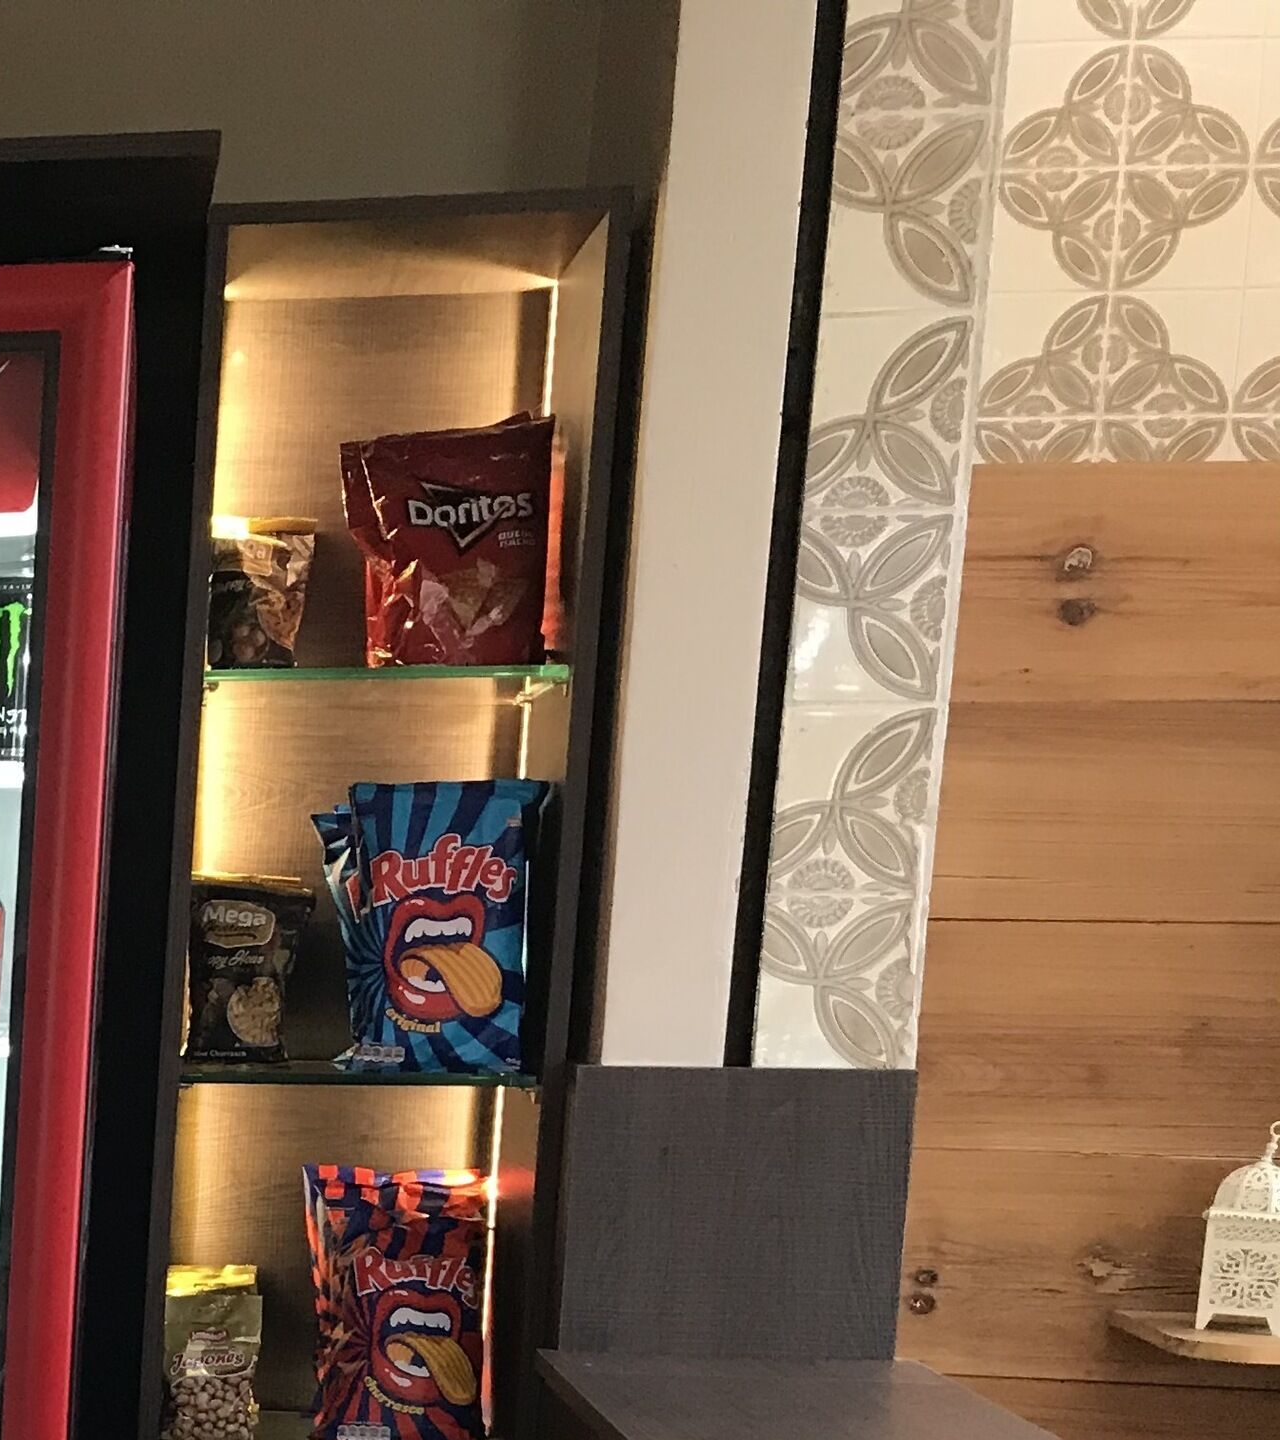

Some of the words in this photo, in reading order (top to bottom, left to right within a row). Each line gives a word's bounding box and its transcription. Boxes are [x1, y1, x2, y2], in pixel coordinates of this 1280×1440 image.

[408, 493, 533, 527] Doritos
[369, 833, 518, 907] Ruffles
[203, 905, 266, 928] Mega
[385, 1008, 441, 1033] original
